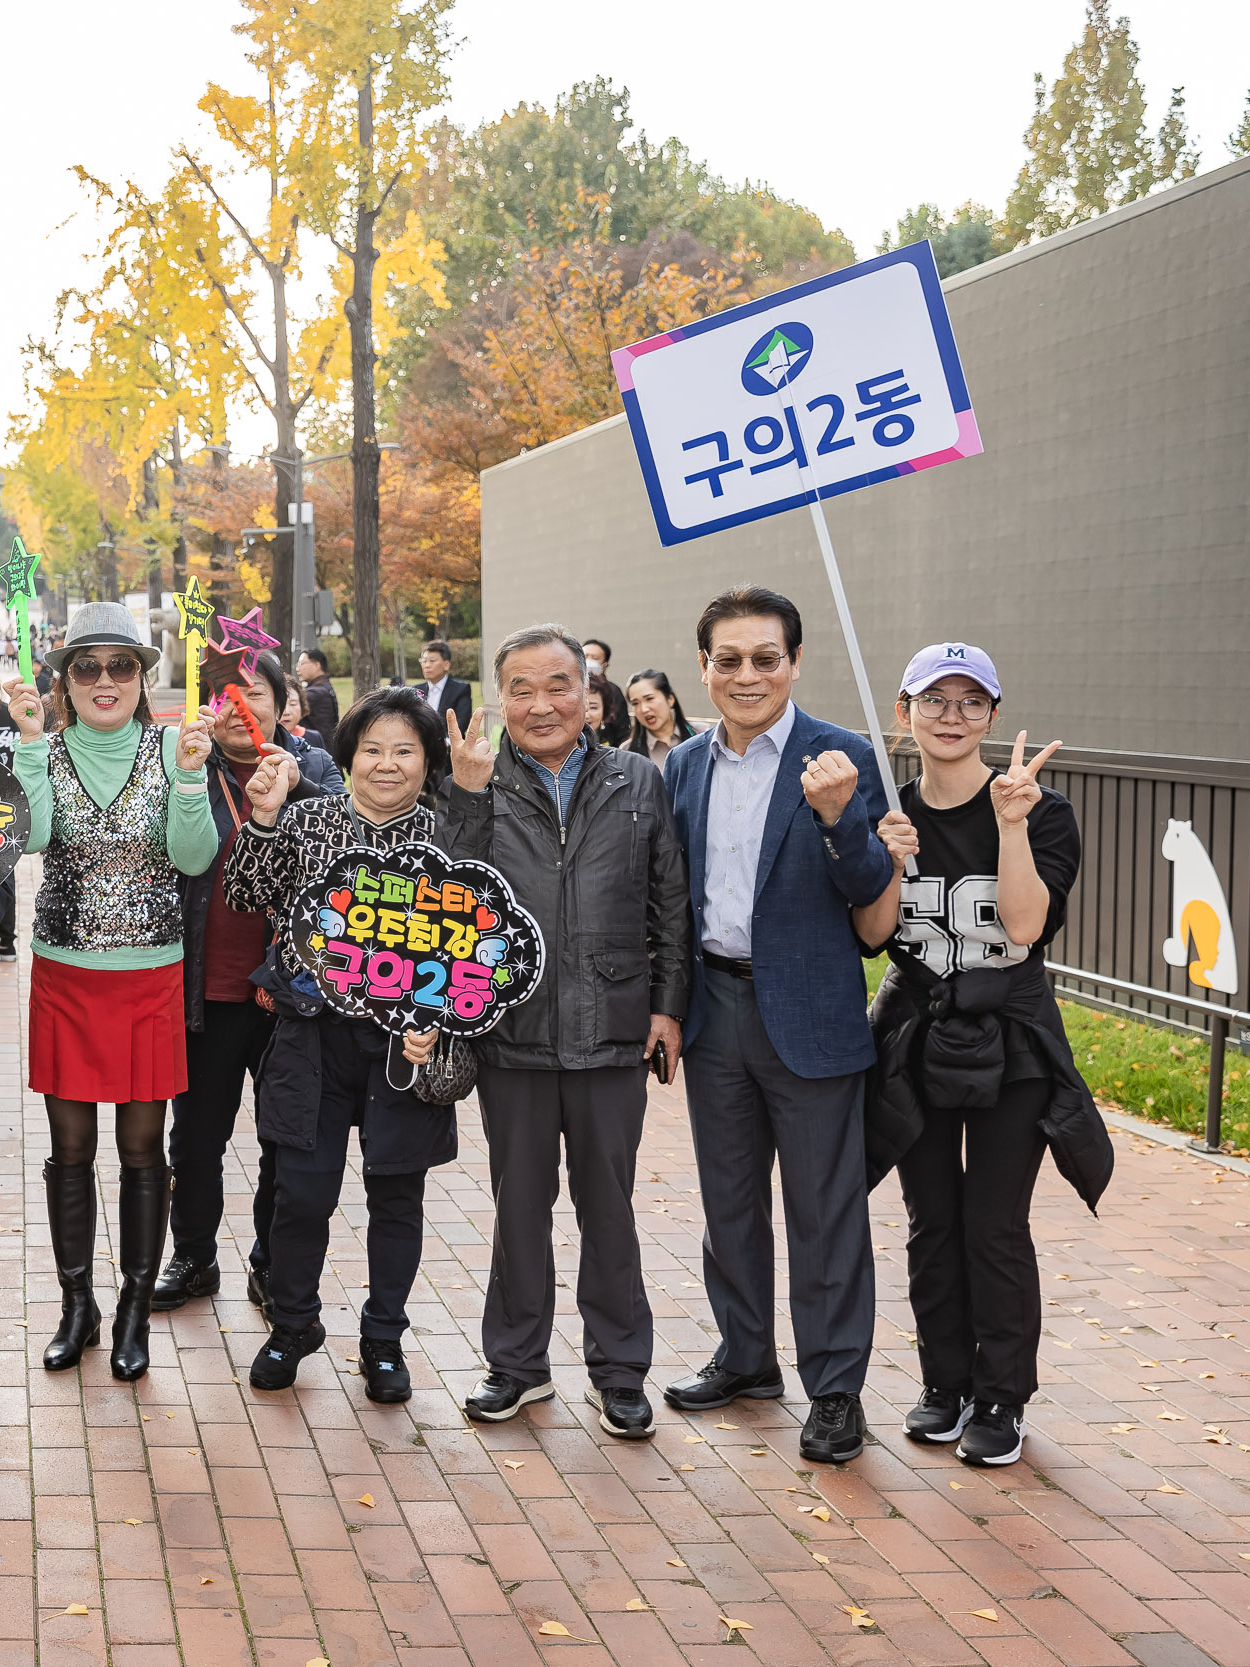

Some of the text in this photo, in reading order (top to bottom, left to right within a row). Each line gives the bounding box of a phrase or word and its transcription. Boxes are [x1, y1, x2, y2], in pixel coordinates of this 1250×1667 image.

[681, 368, 922, 499] 구의2동
[945, 647, 967, 660] M
[354, 867, 478, 913] 슈퍼스타
[346, 904, 480, 960] 우주최강
[324, 940, 493, 1018] 구의2동
